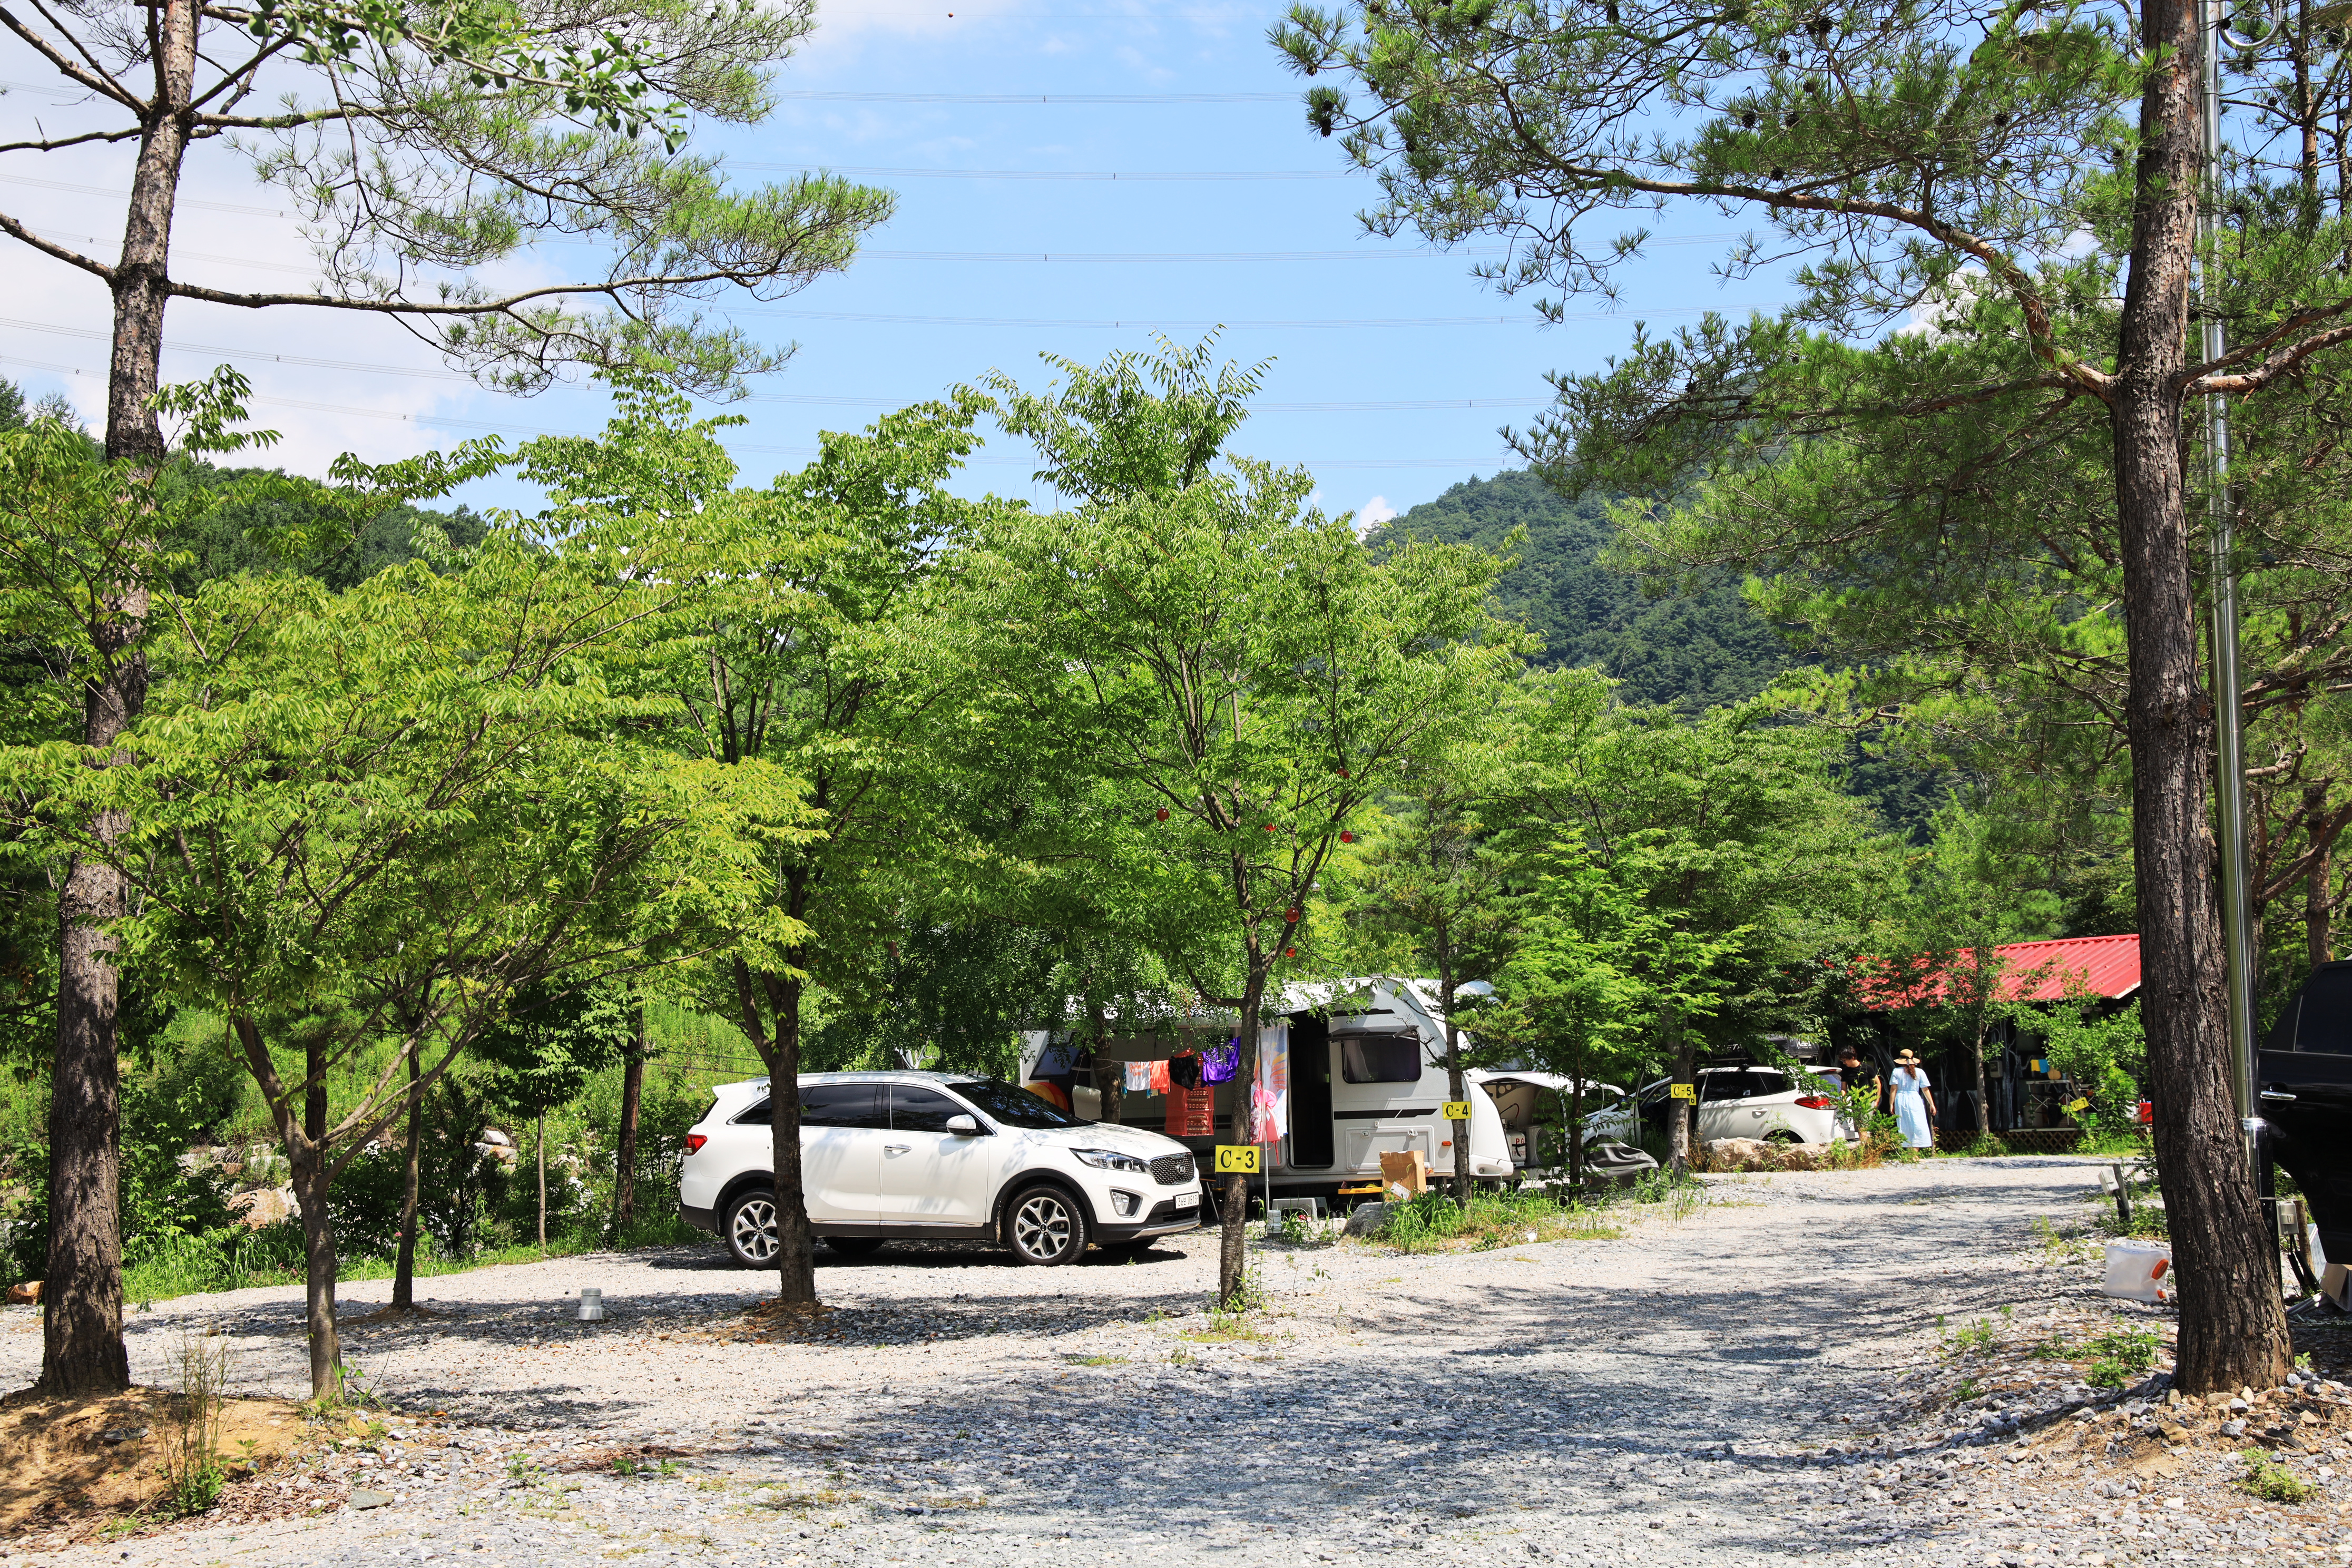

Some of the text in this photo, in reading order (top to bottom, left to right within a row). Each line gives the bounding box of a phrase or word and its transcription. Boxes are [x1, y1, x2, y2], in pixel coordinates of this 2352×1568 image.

[1673, 1086, 1691, 1096] C-5
[2073, 1099, 2085, 1109] C-7
[1446, 1104, 1469, 1117] C-4
[1220, 1150, 1255, 1169] C-3
[1188, 1194, 1197, 1205] 0513
